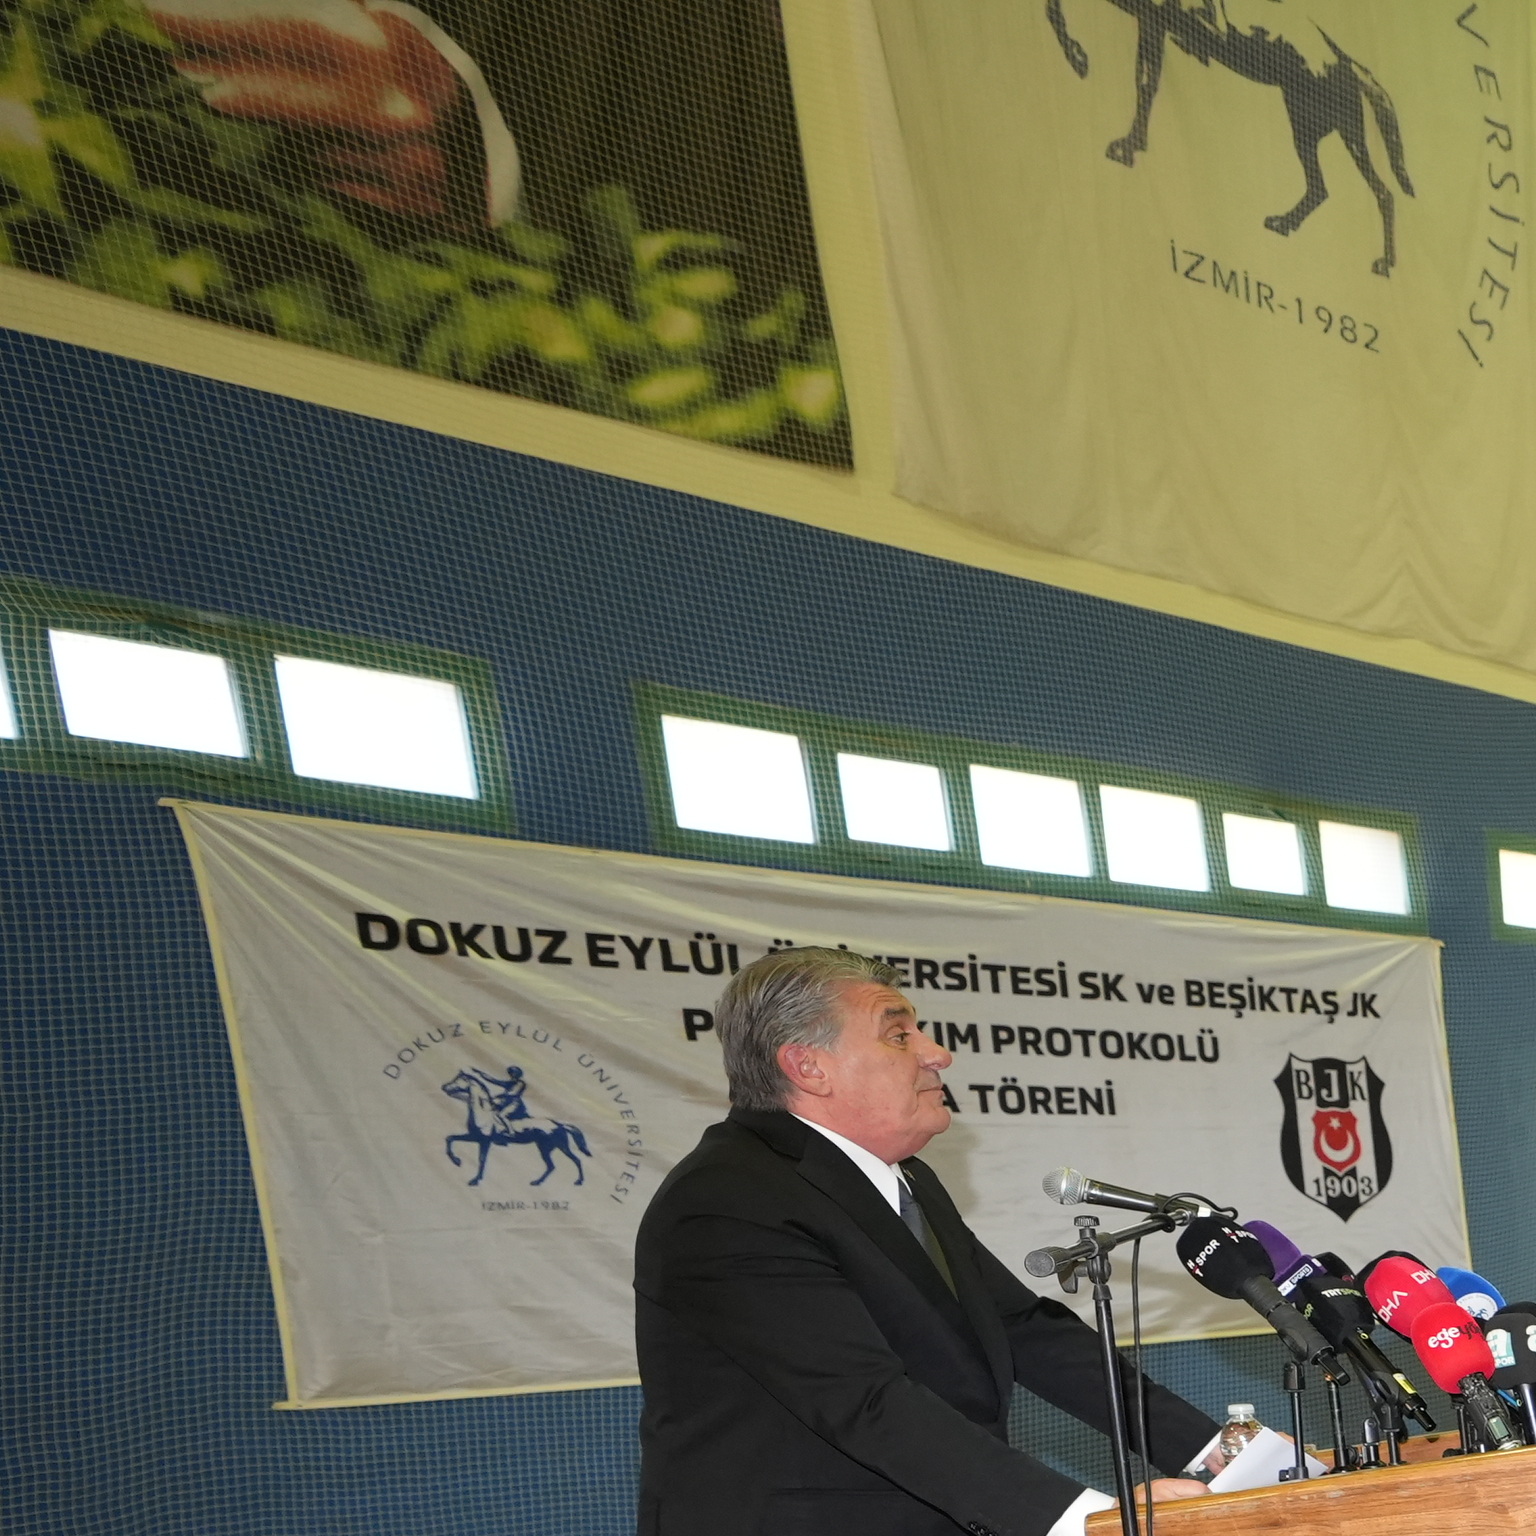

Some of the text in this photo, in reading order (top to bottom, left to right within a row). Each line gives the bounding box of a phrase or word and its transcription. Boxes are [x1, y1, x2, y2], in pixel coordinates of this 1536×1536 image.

[1169, 239, 1380, 354] İZMİR-1982
[355, 911, 573, 965] DOKUZ
[1078, 972, 1127, 1002] SK
[1136, 983, 1175, 1005] ve
[1184, 977, 1339, 1024] BEŞİKTAŞ
[1346, 992, 1381, 1018] JK
[382, 1021, 465, 1080] DOKUZ
[990, 1024, 1220, 1064] PROTOKOLÜ
[969, 1077, 1117, 1116] TÖRENİ
[1294, 1067, 1367, 1102] BJK
[1312, 1174, 1375, 1199] 1903
[1195, 1239, 1221, 1267] SPOR
[1378, 1289, 1409, 1324] DHA
